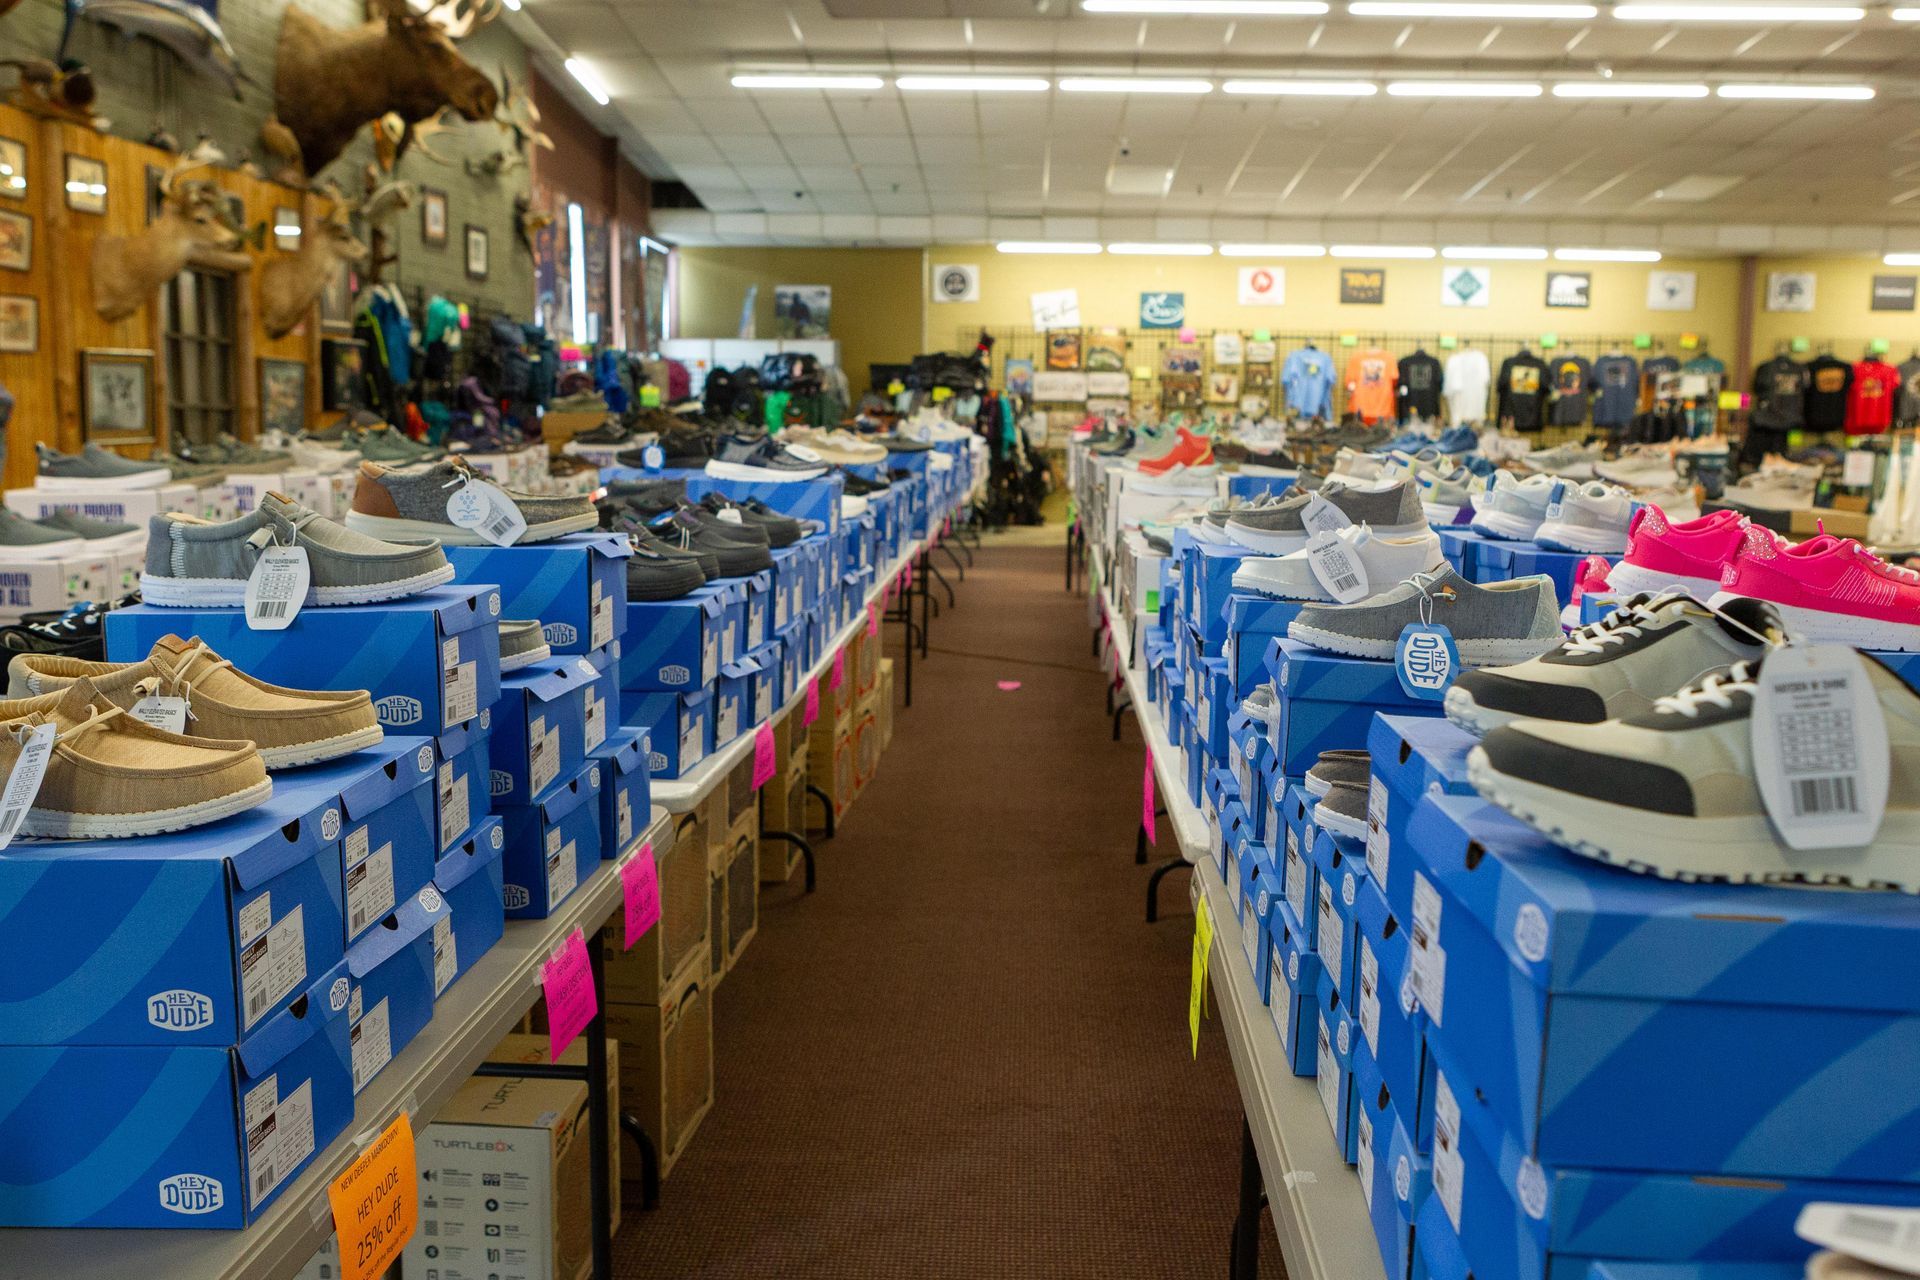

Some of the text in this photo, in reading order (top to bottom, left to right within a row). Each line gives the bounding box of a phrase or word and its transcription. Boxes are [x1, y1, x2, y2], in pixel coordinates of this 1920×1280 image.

[543, 628, 574, 644] DUDE
[1408, 637, 1438, 684] DUDE
[1434, 650, 1446, 676] HEY
[378, 703, 418, 722] DUDE
[388, 698, 410, 707] HEY
[166, 994, 196, 1005] HEY
[152, 1000, 208, 1027] DUDE
[433, 1140, 514, 1152] TURTLEBOX
[178, 1176, 206, 1188] HEY
[341, 1178, 353, 1192] NEW
[354, 1156, 371, 1180] DEEPER
[164, 1184, 218, 1210] DUDE
[357, 1166, 399, 1224] HEY DUDE
[357, 1196, 402, 1268] 25% off
